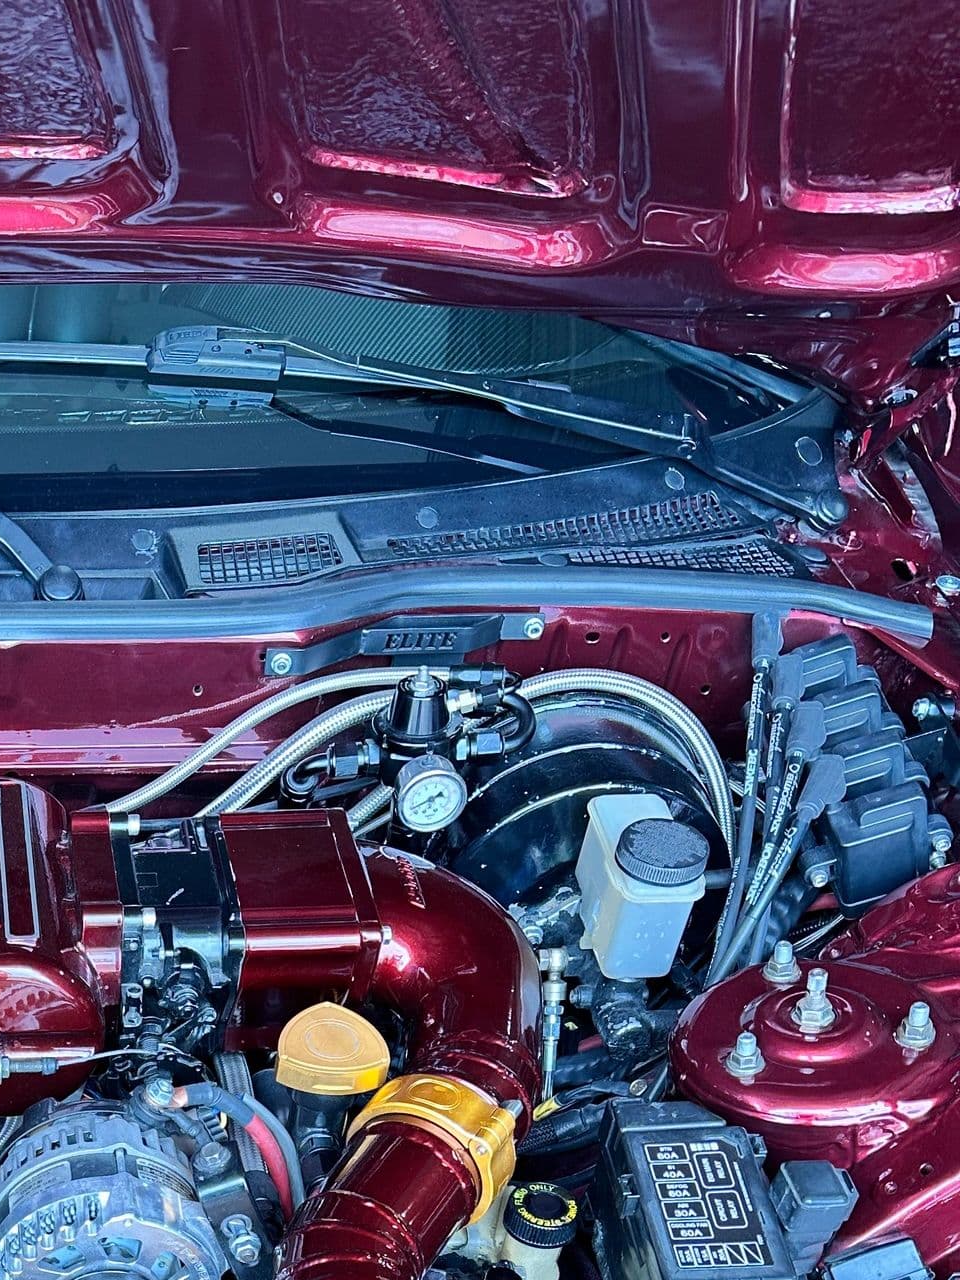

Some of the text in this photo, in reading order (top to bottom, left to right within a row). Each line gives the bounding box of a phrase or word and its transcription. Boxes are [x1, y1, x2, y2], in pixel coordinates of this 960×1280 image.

[383, 631, 458, 652] ELITE
[770, 772, 795, 835] SAKEBOMB
[663, 1170, 685, 1179] 40A
[529, 1184, 555, 1192] ONLY
